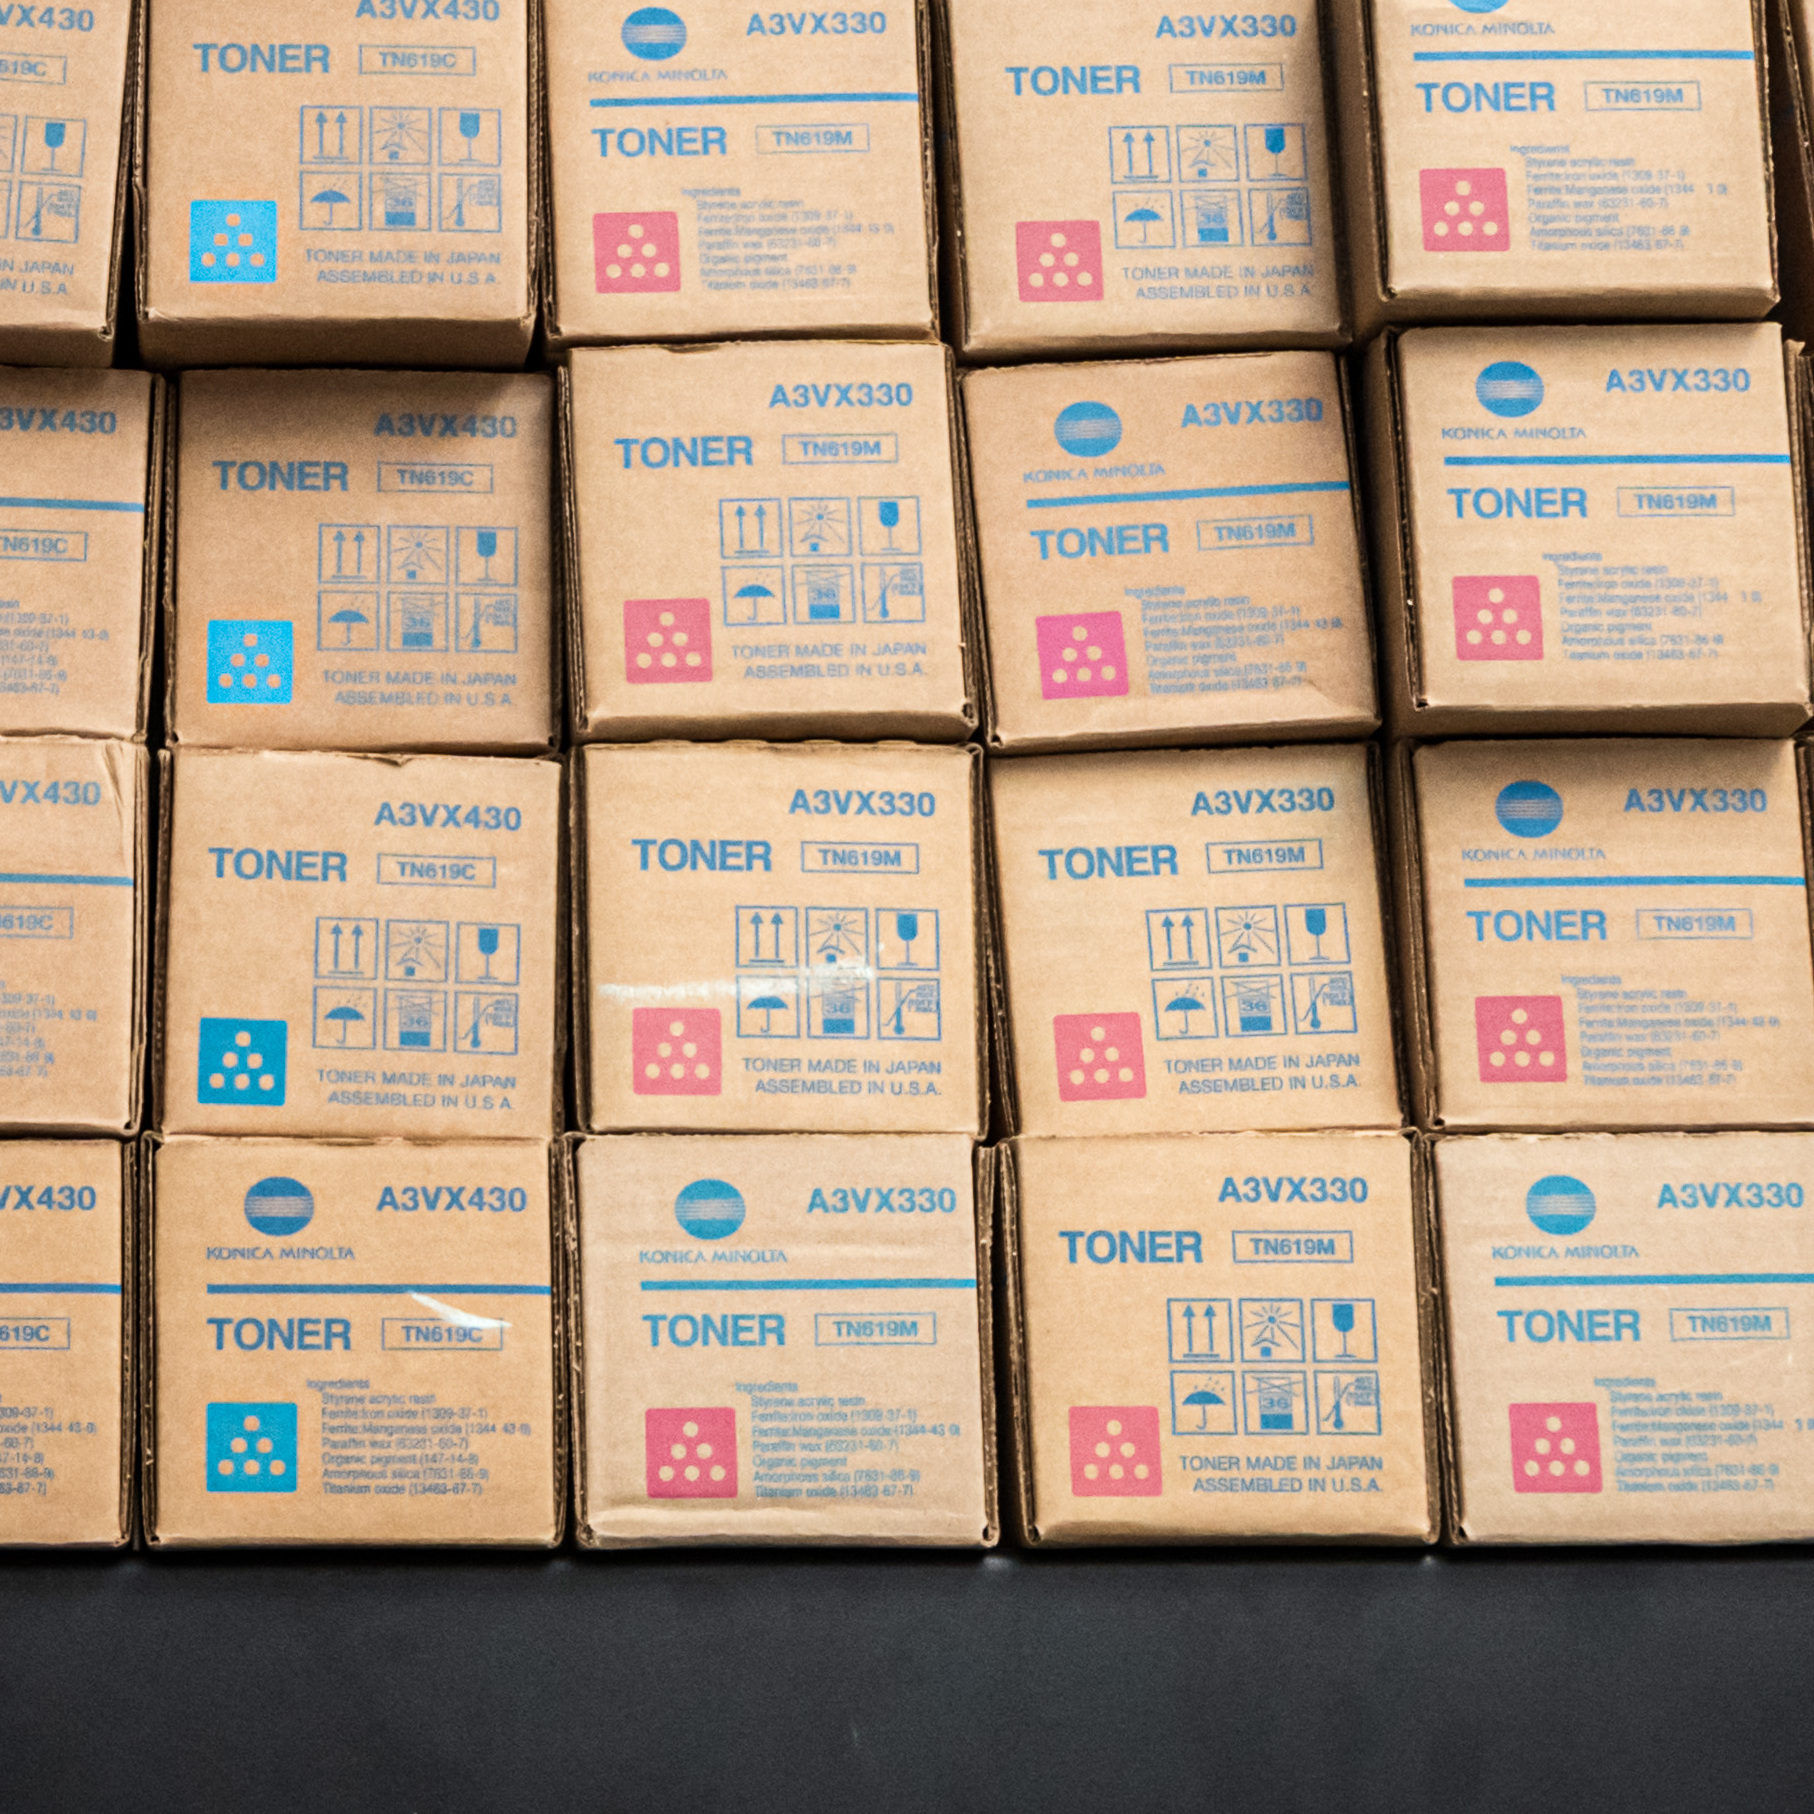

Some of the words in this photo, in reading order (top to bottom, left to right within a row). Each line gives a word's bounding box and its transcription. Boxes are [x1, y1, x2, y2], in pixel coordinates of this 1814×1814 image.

[771, 384, 914, 409] A3VX330
[615, 437, 754, 470] TONER
[801, 438, 882, 458] TN619M
[733, 645, 789, 659] TONER
[795, 643, 843, 657] MADE
[850, 643, 866, 656] IN
[856, 663, 871, 676] IN
[1193, 788, 1336, 816] A3VX330
[1039, 845, 1179, 881] TONER
[1225, 845, 1307, 867] TN619M
[1165, 1058, 1222, 1074] TONER
[1228, 1056, 1276, 1071] MADE
[1283, 1055, 1299, 1068] IN
[1289, 1076, 1305, 1090] IN
[808, 1188, 957, 1214] A3VX330
[1219, 1178, 1369, 1205] A3VX330
[1059, 1231, 1204, 1265] TONER
[1252, 1236, 1337, 1257] TN619M
[643, 1315, 786, 1348] TONER
[835, 1319, 919, 1339] TN619M
[1180, 1455, 1240, 1471] TONER
[1246, 1456, 1297, 1471] MADE
[1304, 1457, 1320, 1470] IN
[1309, 1478, 1325, 1492] IN
